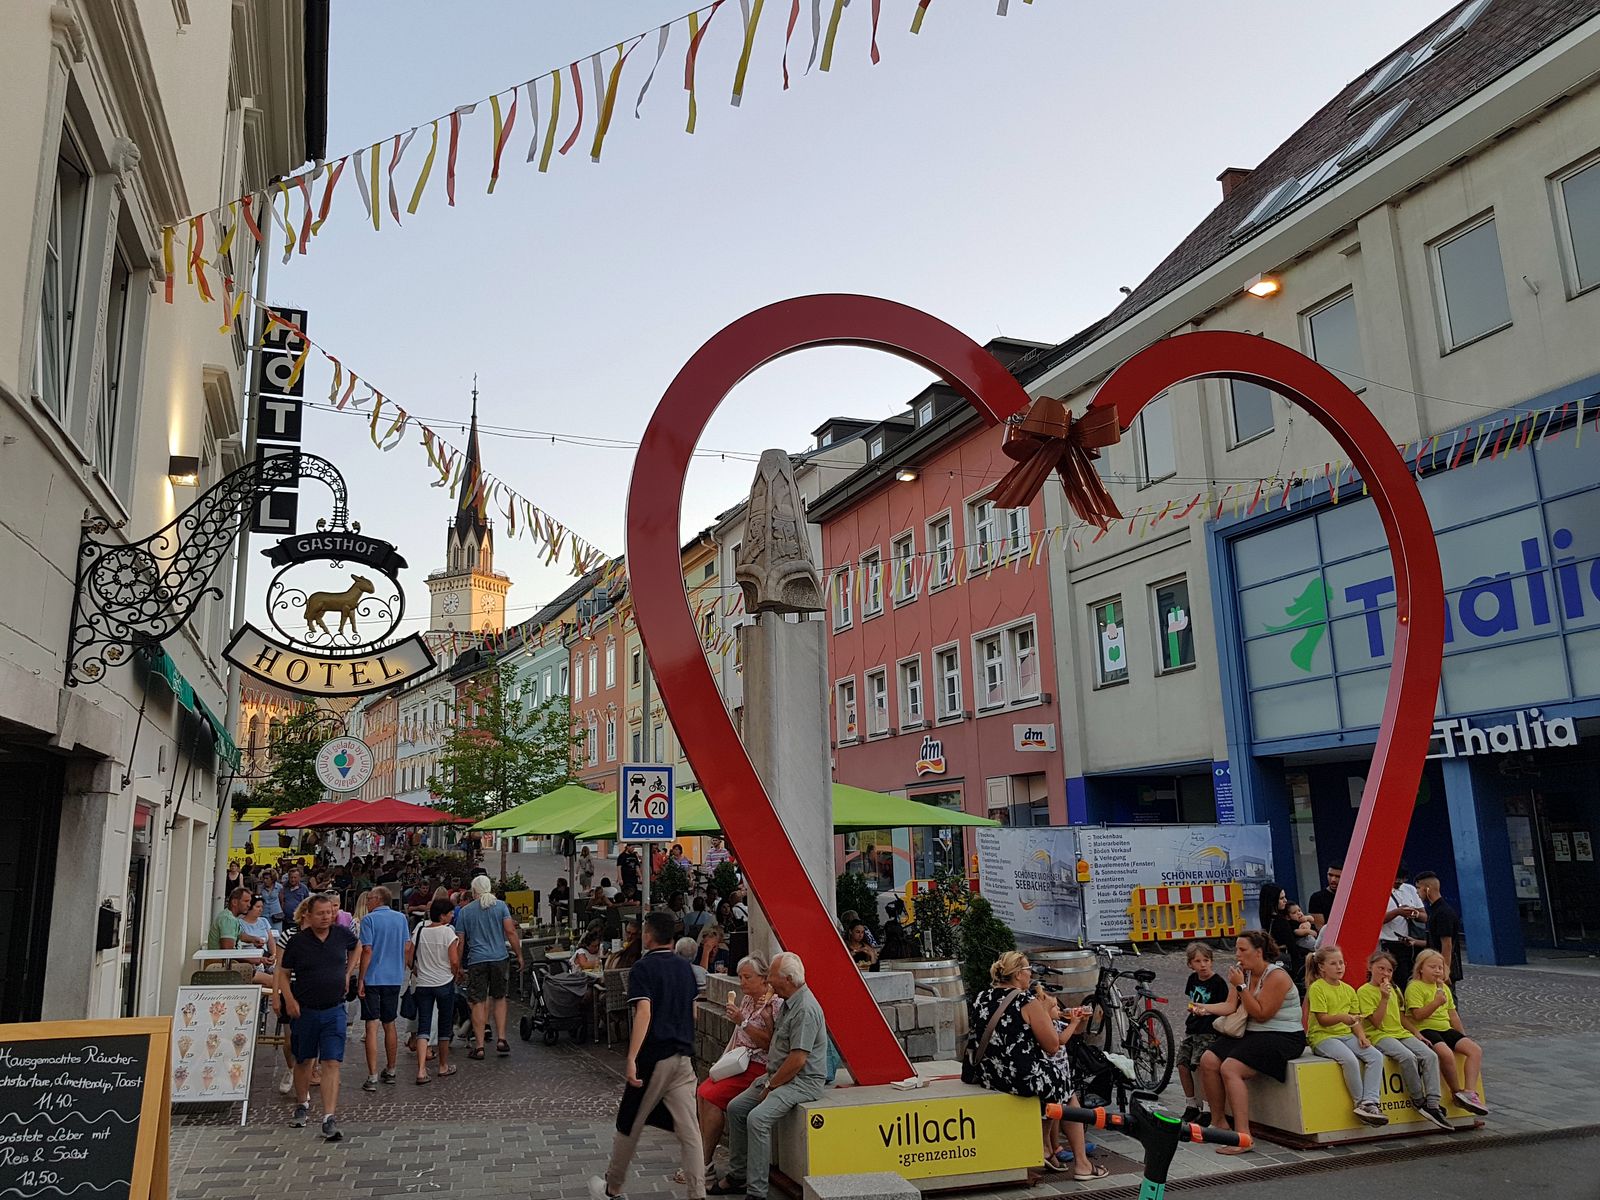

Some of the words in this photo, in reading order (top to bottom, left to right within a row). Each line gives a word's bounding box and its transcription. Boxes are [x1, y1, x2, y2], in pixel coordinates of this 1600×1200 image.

[260, 311, 301, 527] HOTEL
[297, 537, 378, 556] GASTHOF
[1345, 527, 1600, 658] Tali
[253, 644, 404, 688] HOTEL
[1024, 728, 1043, 740] dm
[1433, 708, 1577, 757] Thalia
[333, 740, 355, 752] gelato
[355, 746, 364, 755] by
[360, 754, 370, 773] LUIS
[921, 738, 941, 760] dm
[319, 754, 329, 774] LUIS
[334, 775, 358, 787] gelato
[652, 802, 665, 815] 20
[632, 822, 664, 834] Zone
[1161, 869, 1203, 880] SCHÖNER
[1205, 869, 1246, 879] WOHNEN
[1016, 880, 1051, 891] SEEBACHER
[0, 1048, 81, 1070] Hausgemachtes
[81, 1046, 139, 1064] Räucher-
[0, 1073, 53, 1088] chstartare,
[112, 1072, 143, 1088] Toast
[0, 1128, 44, 1144] eröstete
[47, 1128, 84, 1142] Leber
[92, 1127, 111, 1139] mit
[879, 1108, 976, 1147] villach
[0, 1147, 29, 1167] Reis
[32, 1148, 45, 1162] &
[50, 1146, 89, 1162] Salat
[899, 1145, 977, 1167] :grenzenlos
